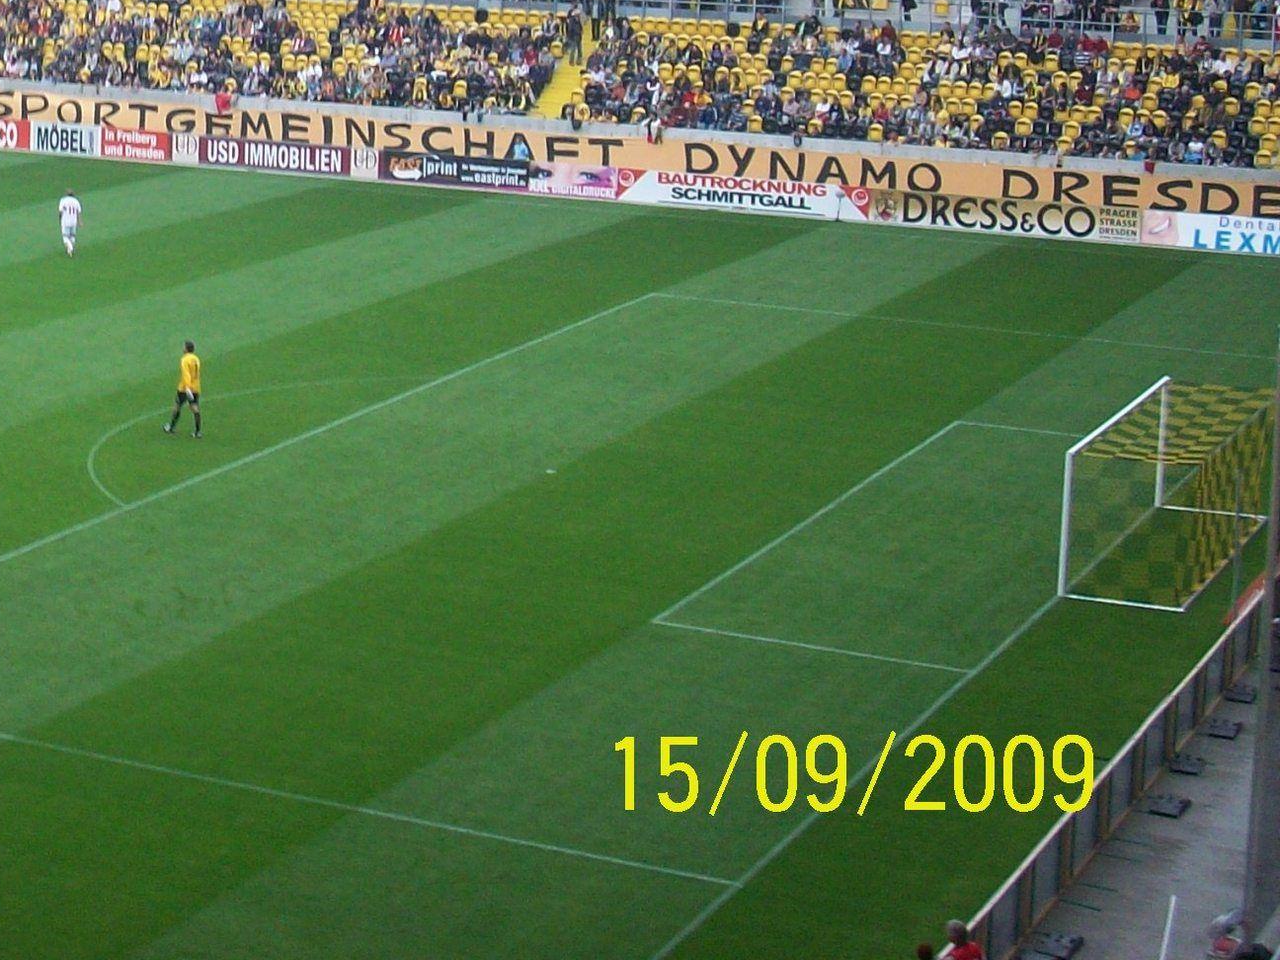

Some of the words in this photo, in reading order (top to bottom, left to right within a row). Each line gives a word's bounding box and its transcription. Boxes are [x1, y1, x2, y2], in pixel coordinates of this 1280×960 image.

[36, 124, 87, 154] MÖBEL
[104, 143, 123, 156] und
[125, 143, 165, 160] Dresden
[207, 139, 239, 165] USD
[253, 142, 352, 173] IMMOBILIEN
[683, 142, 943, 192] DYNAMO
[657, 172, 828, 197] BAUTROCKNUNG
[671, 186, 812, 211] SCHMITTGALL
[1099, 208, 1138, 219] PRAGER
[1099, 217, 1138, 228] STRASSE
[1098, 226, 1138, 237] DRESDEN
